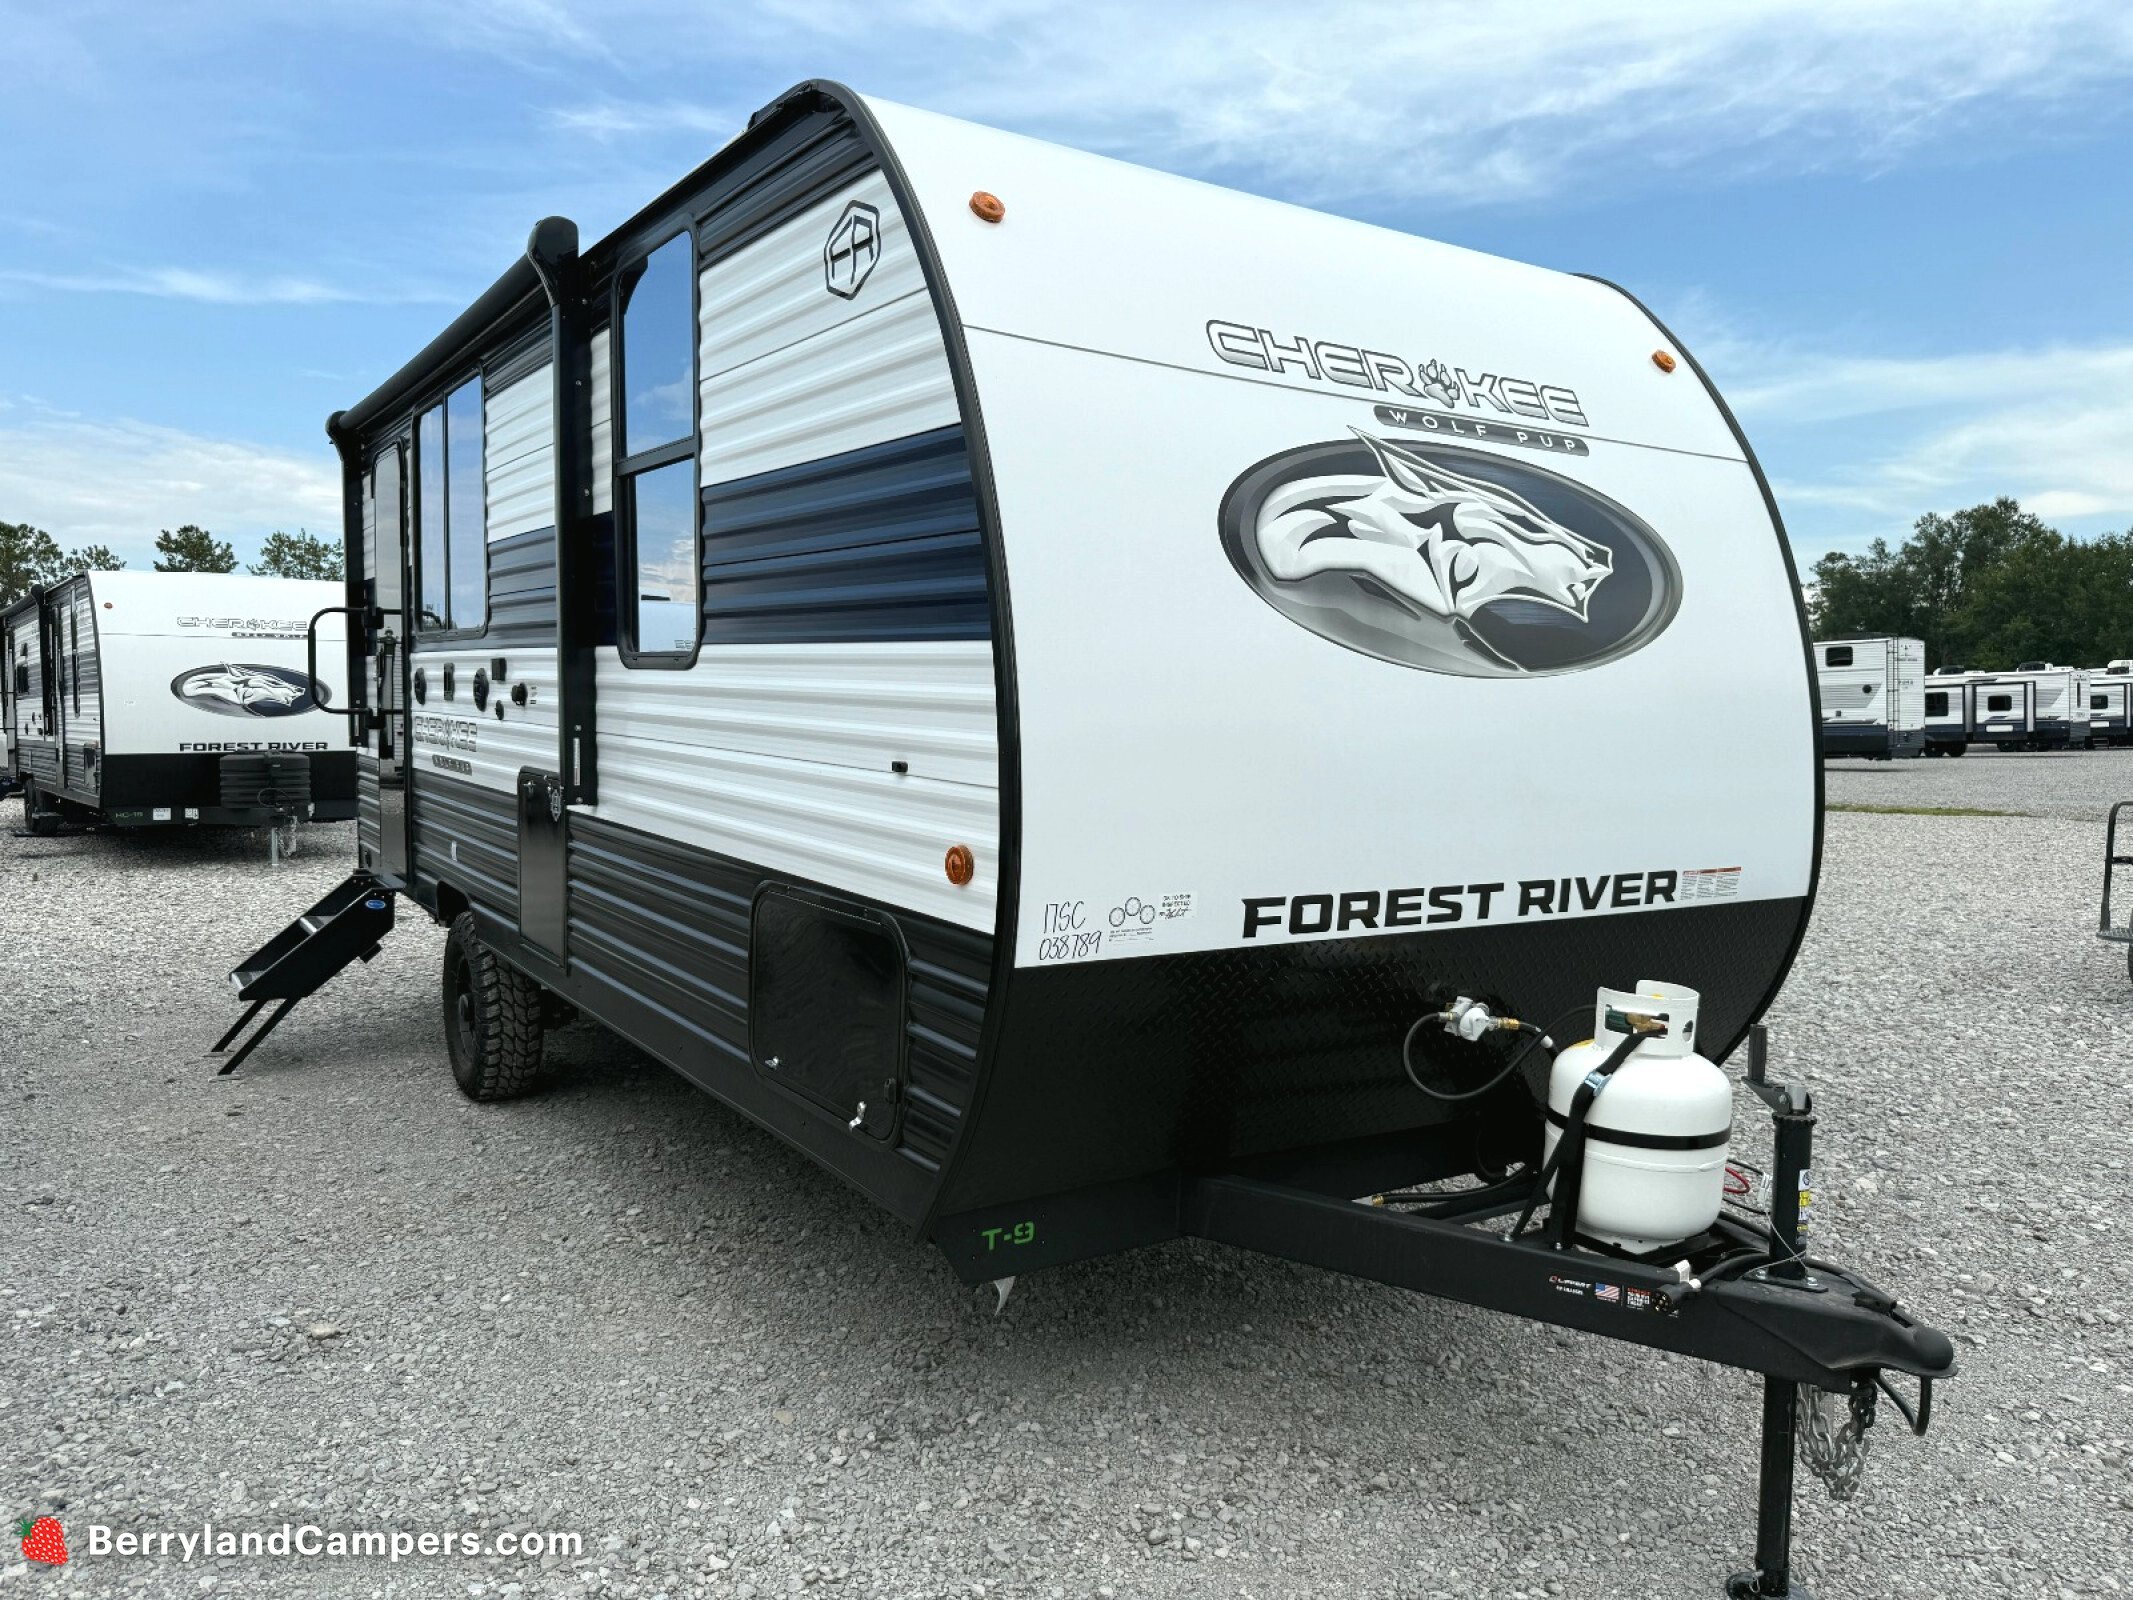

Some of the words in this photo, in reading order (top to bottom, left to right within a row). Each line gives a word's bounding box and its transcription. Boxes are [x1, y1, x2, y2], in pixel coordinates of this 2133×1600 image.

[1205, 320, 1589, 428] CHEROKEE
[1389, 410, 1487, 437] WOLF
[1516, 430, 1578, 452] PUP
[179, 742, 263, 751] FOREST
[268, 742, 329, 751] RIVER
[1240, 882, 1504, 939] FOREST
[1517, 870, 1678, 917] RIVER
[1039, 931, 1102, 960] 038789
[981, 1221, 1034, 1251] T-9
